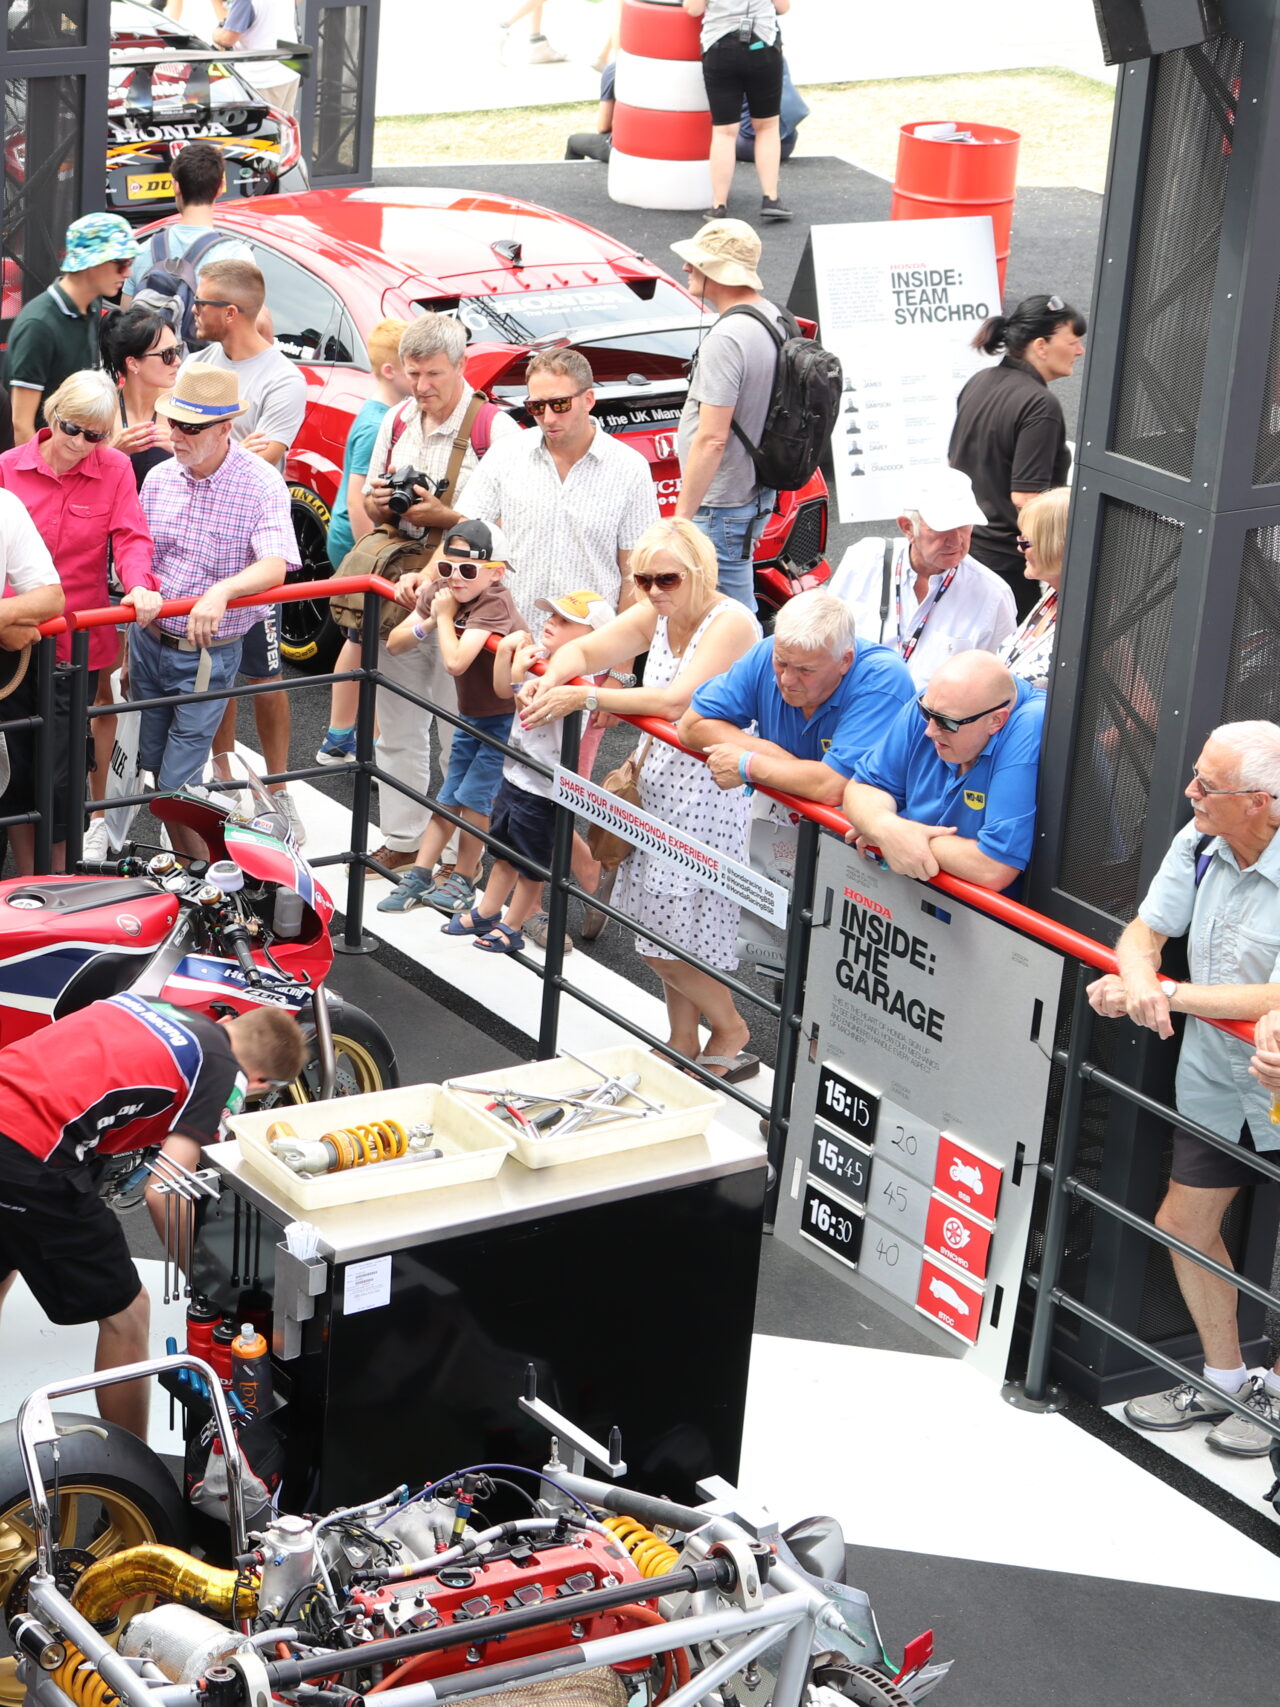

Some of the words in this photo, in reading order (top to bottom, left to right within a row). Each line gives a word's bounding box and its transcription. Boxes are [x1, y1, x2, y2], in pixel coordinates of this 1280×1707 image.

[111, 122, 233, 144] HONDA
[891, 269, 963, 289] INSIDE:
[490, 291, 632, 313] HONDA
[892, 288, 949, 307] TEAM
[894, 303, 990, 325] SYNCHRO
[609, 413, 628, 427] the
[631, 410, 651, 424] UK
[965, 791, 984, 805] WD-40
[559, 776, 586, 797] SHARE
[587, 789, 608, 810] YOUR
[609, 803, 667, 841] #INSIDEHONDA
[668, 835, 719, 871] EXPERIENCE
[843, 886, 893, 920] HONDA
[841, 899, 936, 976] INSIDE:
[839, 927, 890, 981] THE
[835, 958, 946, 1043] GARAGE
[140, 1010, 189, 1047] Racing
[824, 1079, 871, 1128] 15:15
[113, 1151, 134, 1160] HONDA
[890, 1125, 918, 1156] 20
[817, 1138, 864, 1187] 15:45
[883, 1181, 909, 1213] 45
[957, 1190, 973, 1204] BSB
[809, 1198, 853, 1244] 16:30
[876, 1238, 901, 1268] 40
[939, 1246, 970, 1269] SYNCHRO
[938, 1310, 956, 1327] BTCC
